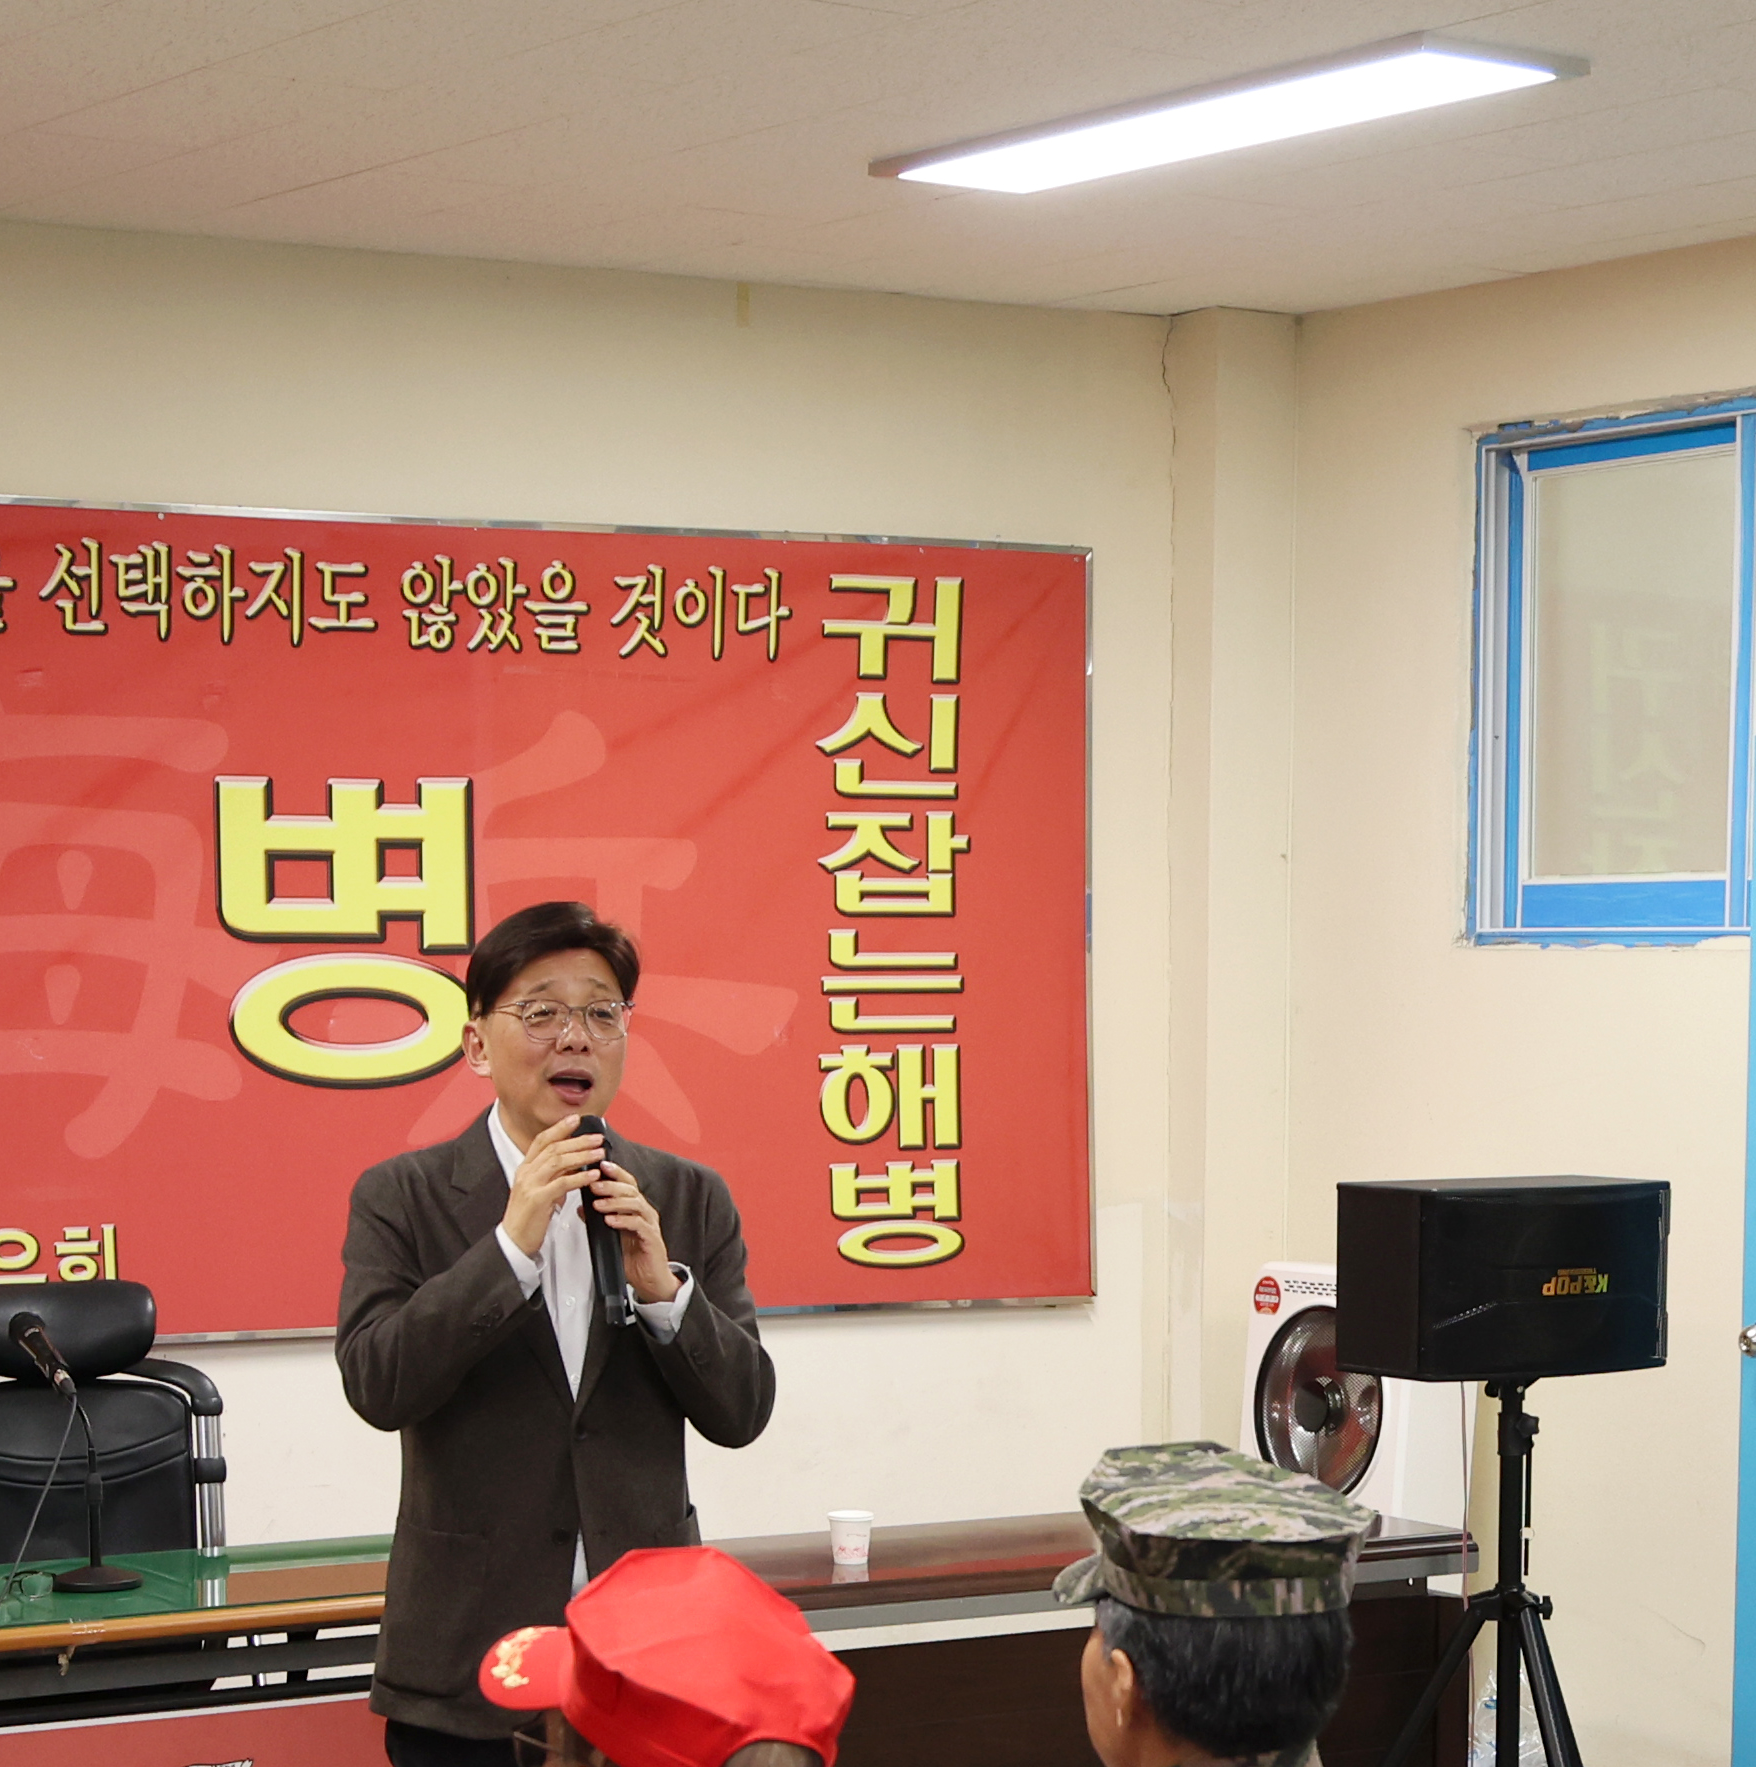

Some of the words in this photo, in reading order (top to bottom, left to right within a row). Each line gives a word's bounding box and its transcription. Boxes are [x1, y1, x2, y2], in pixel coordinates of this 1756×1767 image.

[38, 534, 380, 648] 선택하지도
[400, 553, 590, 655] 않았을
[609, 561, 793, 662] 것이다
[214, 774, 474, 1088] 병
[815, 572, 971, 1268] 귀신잡는해병
